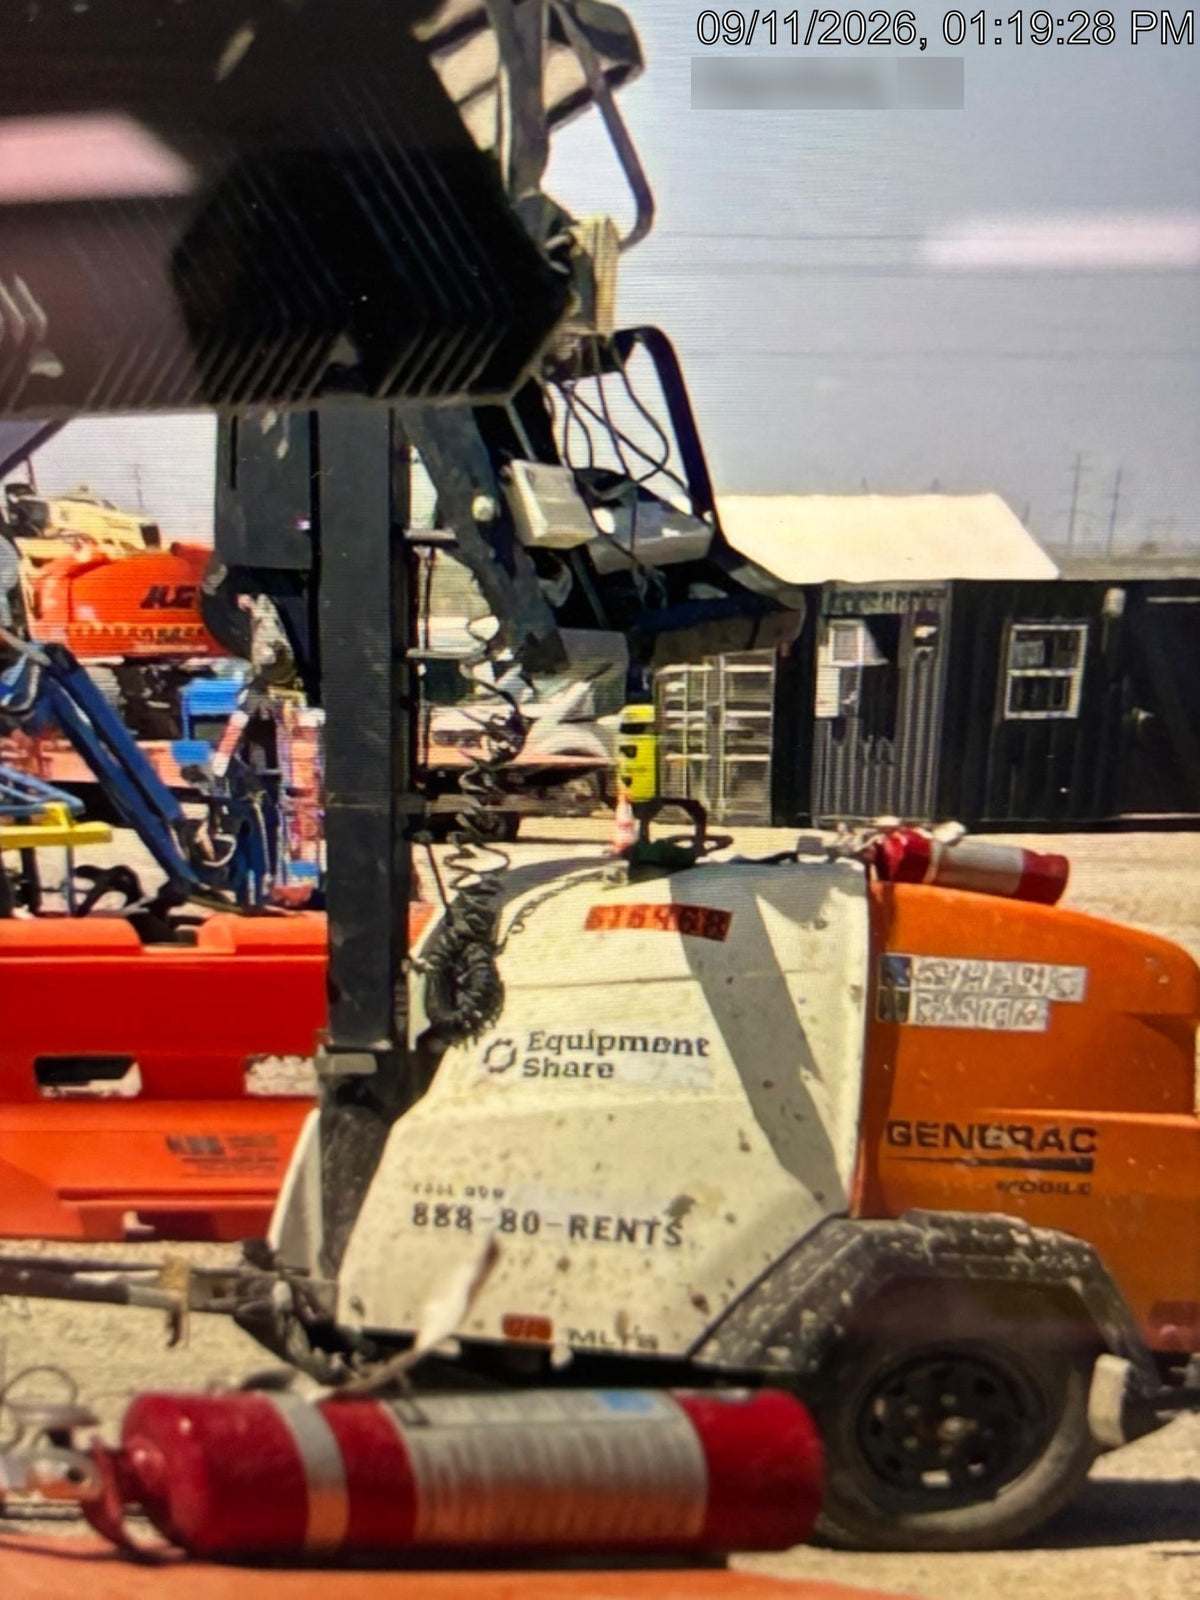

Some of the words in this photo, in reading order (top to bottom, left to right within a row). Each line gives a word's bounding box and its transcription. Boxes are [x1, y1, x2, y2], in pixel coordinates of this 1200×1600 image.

[525, 1029, 710, 1057] Equipment
[522, 1057, 616, 1079] Share
[411, 1201, 684, 1247] 888-80-RENTS
